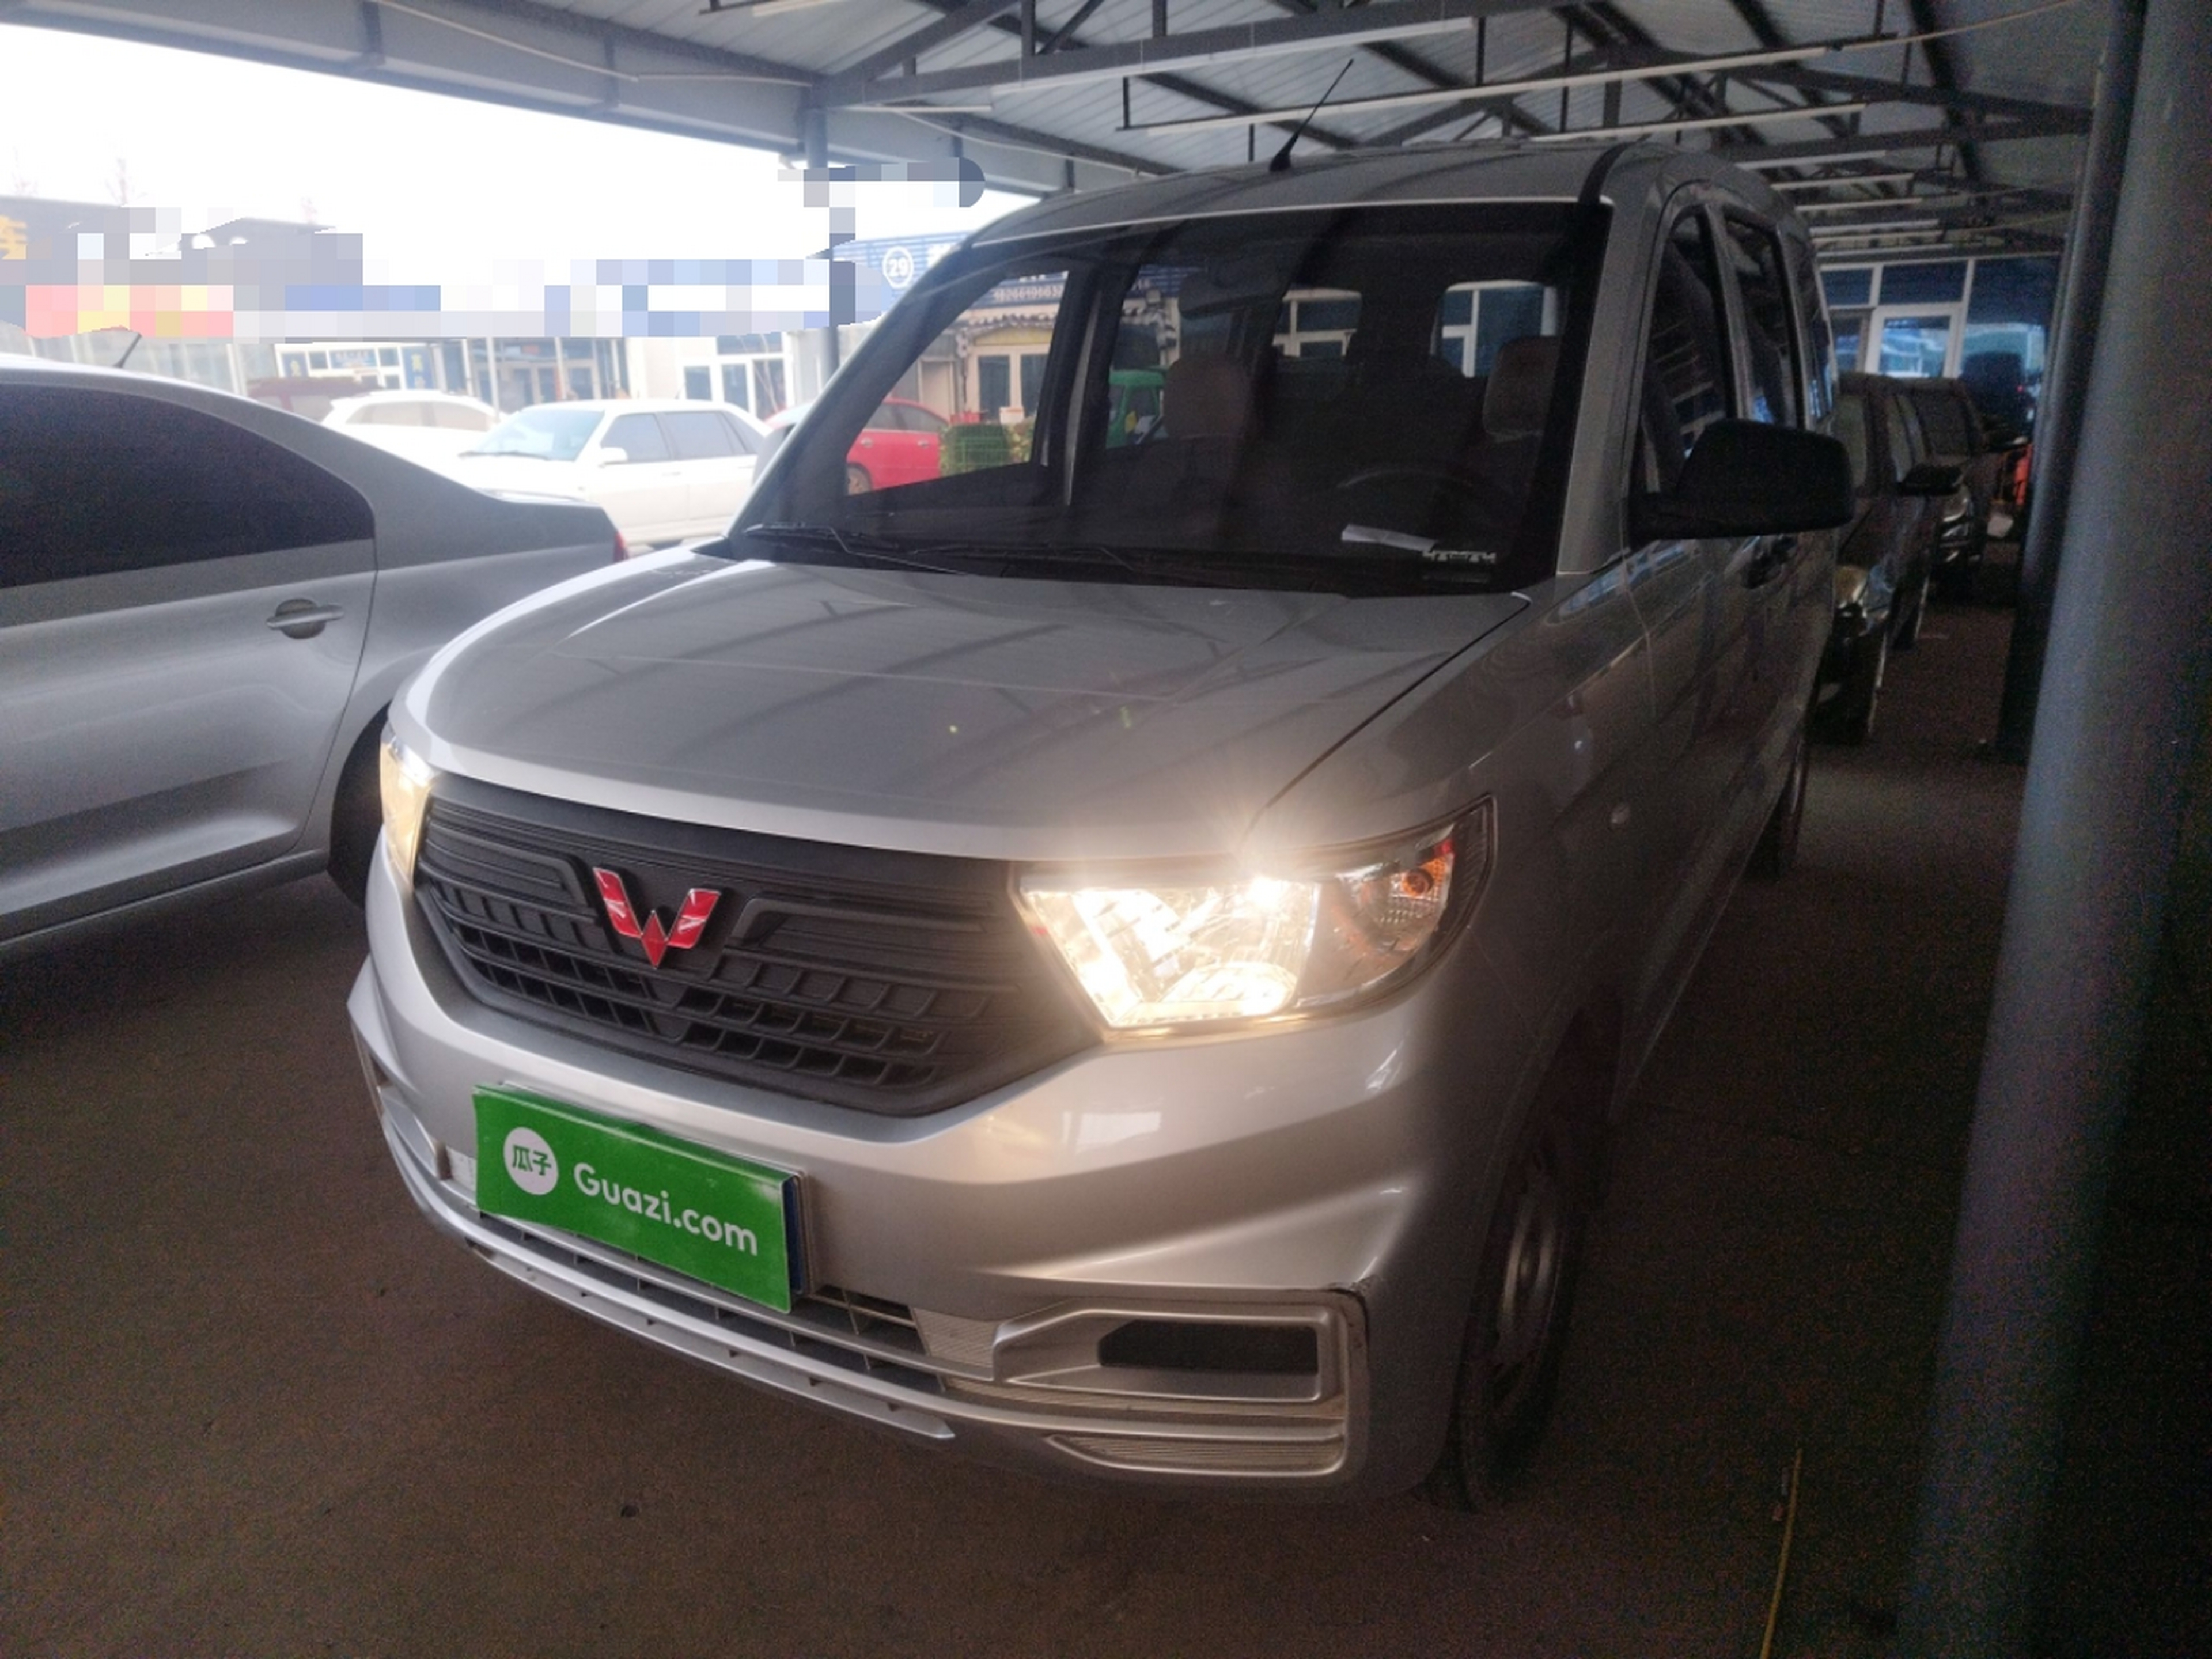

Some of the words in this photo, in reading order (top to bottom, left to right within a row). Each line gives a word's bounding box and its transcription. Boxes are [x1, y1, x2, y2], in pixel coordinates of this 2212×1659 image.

[889, 257, 907, 276] 29
[512, 1145, 552, 1176] 瓜子
[574, 1162, 757, 1256] Guazi.com
